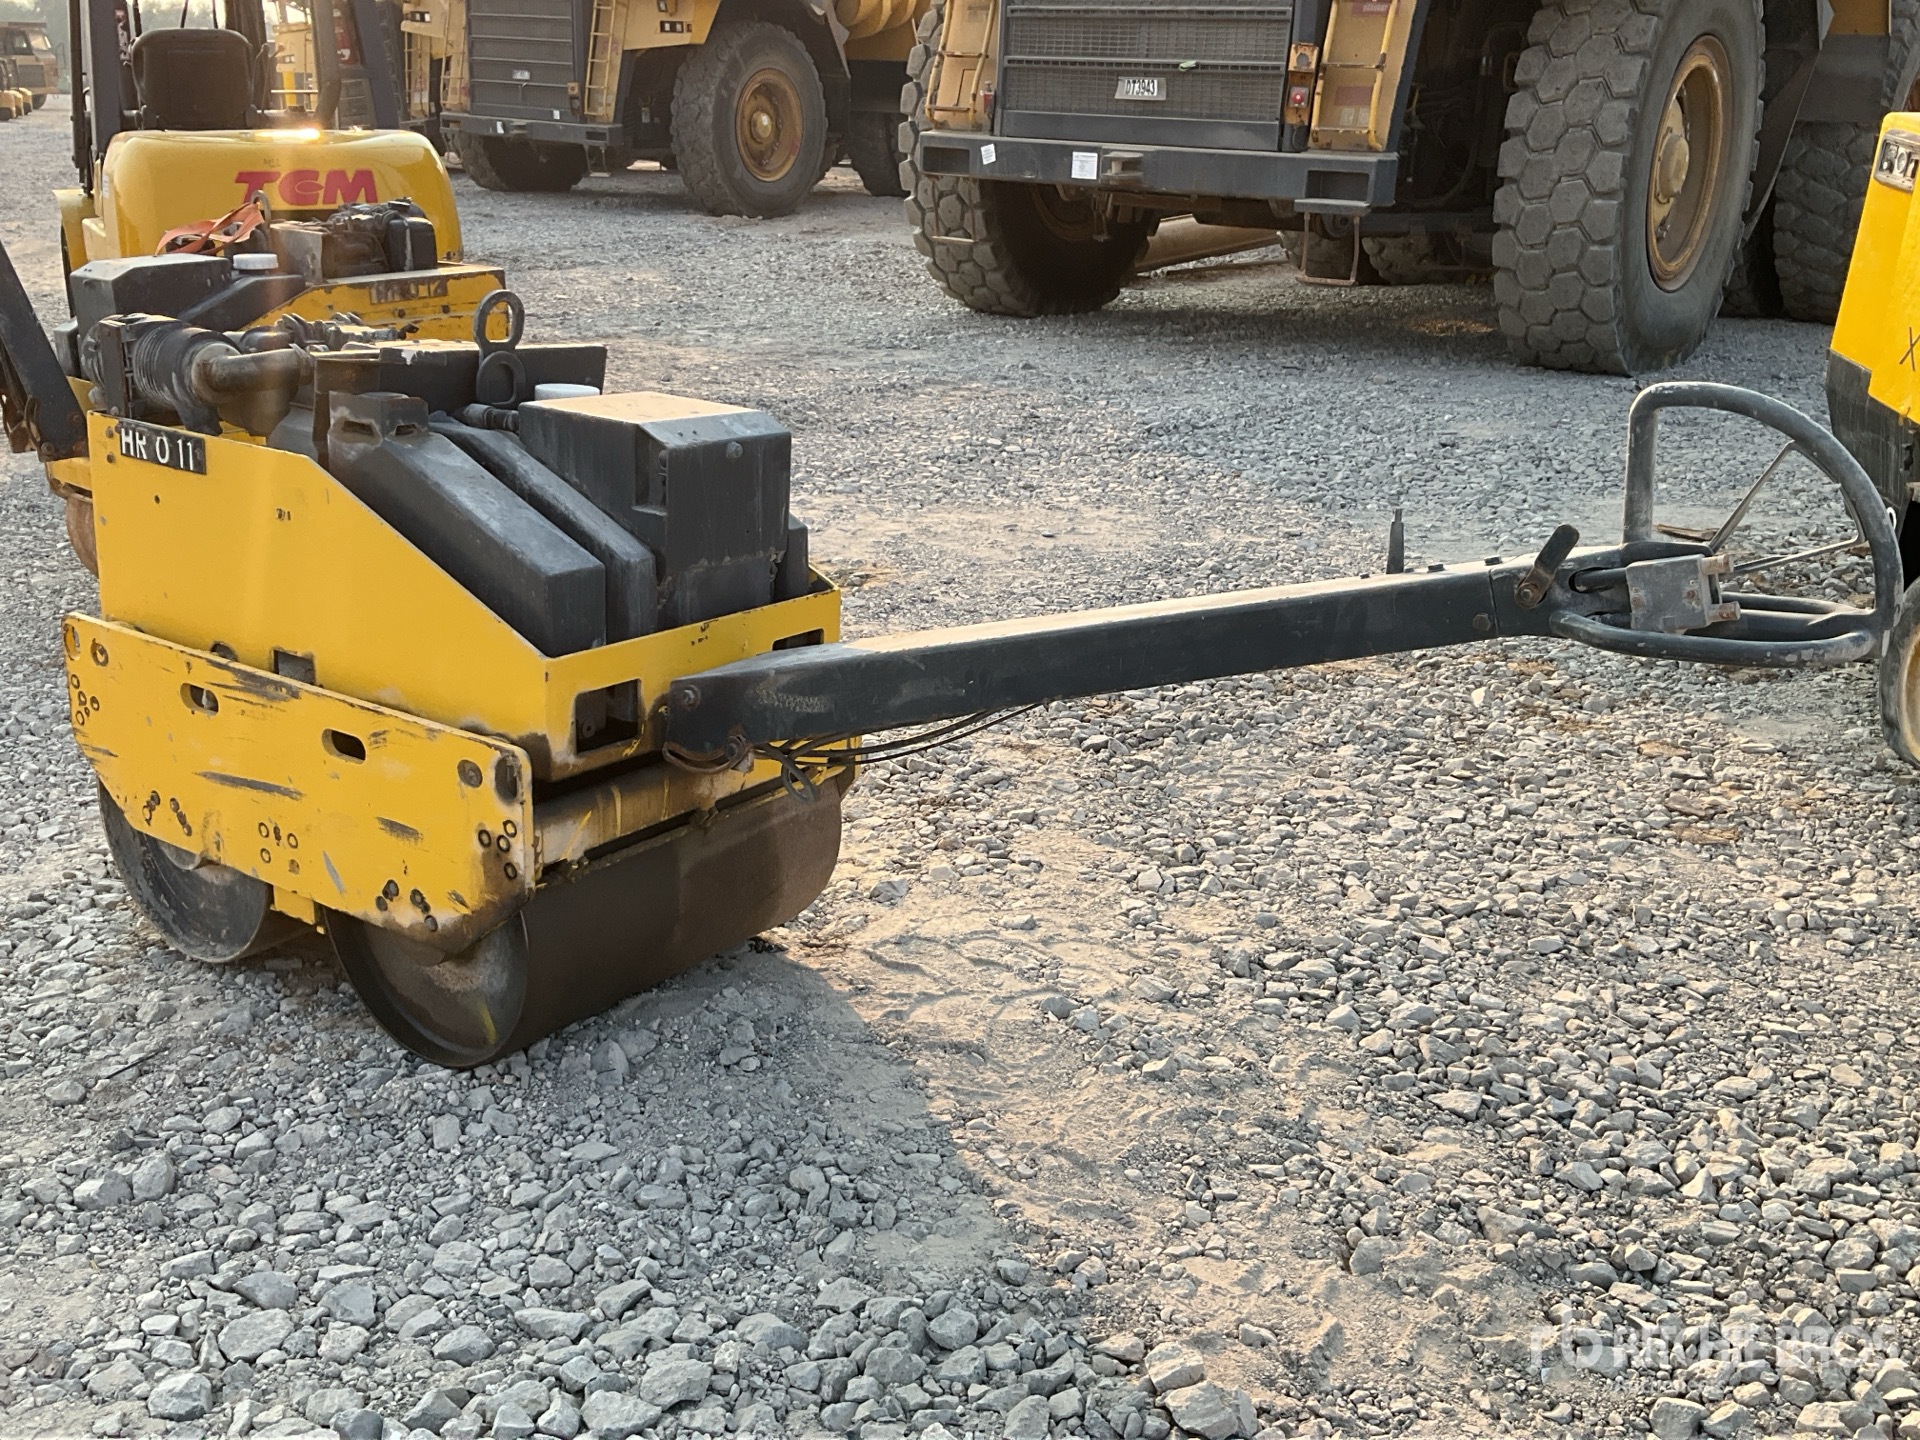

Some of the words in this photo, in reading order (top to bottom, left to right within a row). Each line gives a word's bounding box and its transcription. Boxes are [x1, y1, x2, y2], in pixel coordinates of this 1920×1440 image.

[1124, 79, 1156, 95] DT3943
[235, 168, 378, 206] TCM
[121, 427, 147, 460] HR
